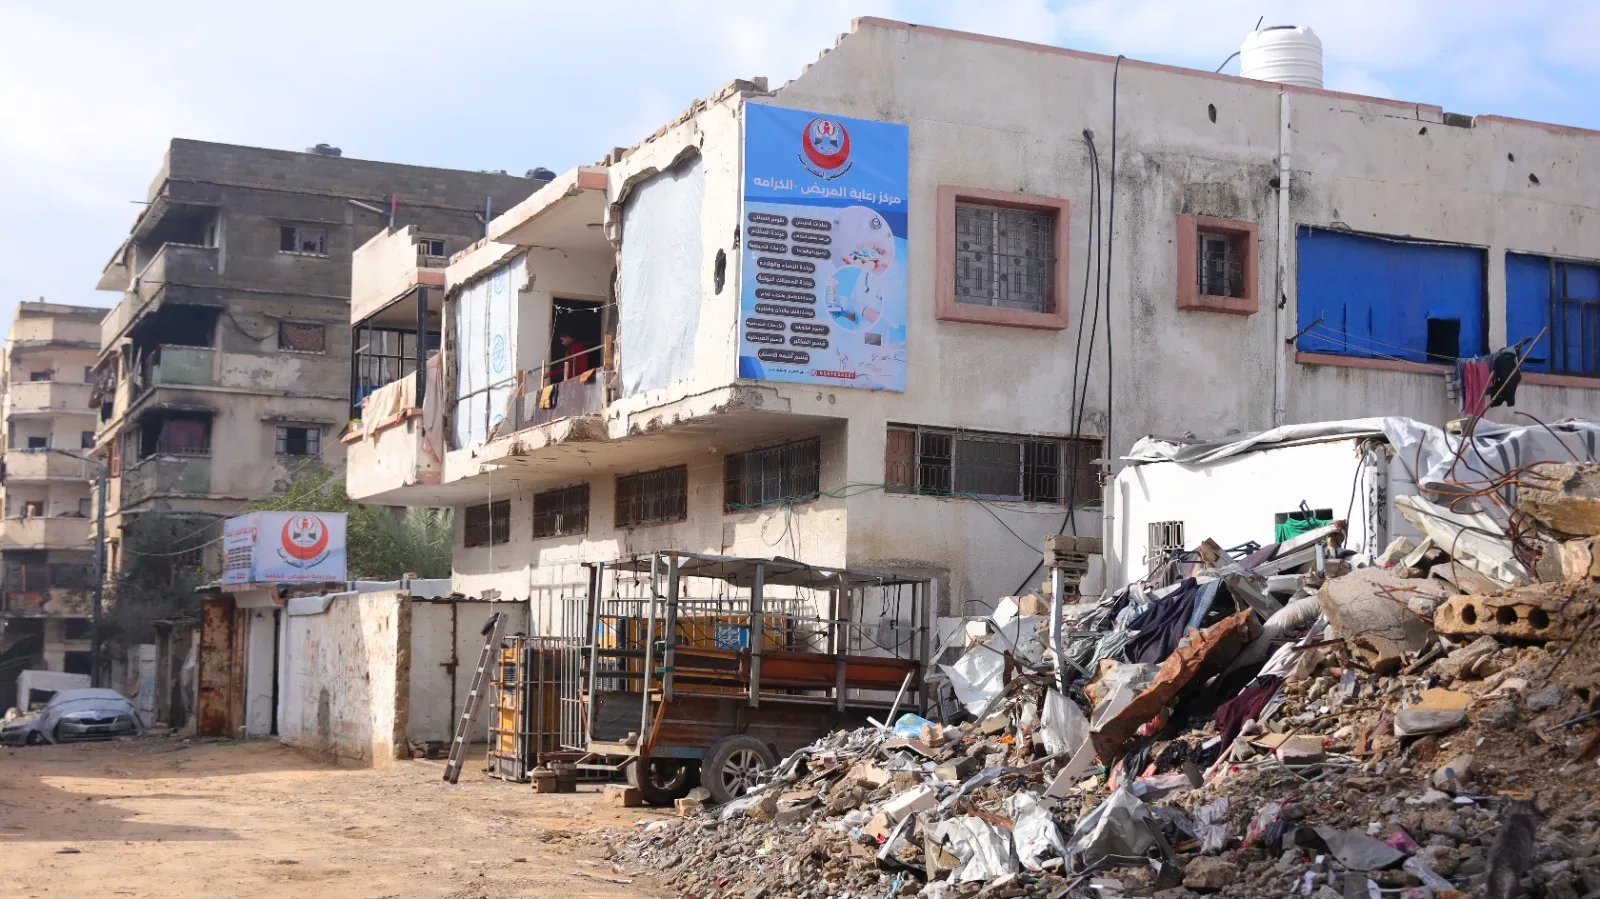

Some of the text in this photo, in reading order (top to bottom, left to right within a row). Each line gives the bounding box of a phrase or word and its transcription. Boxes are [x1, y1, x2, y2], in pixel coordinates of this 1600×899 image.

[800, 182, 847, 199] المريض
[849, 187, 876, 204] رعاية
[878, 192, 902, 206] مركز
